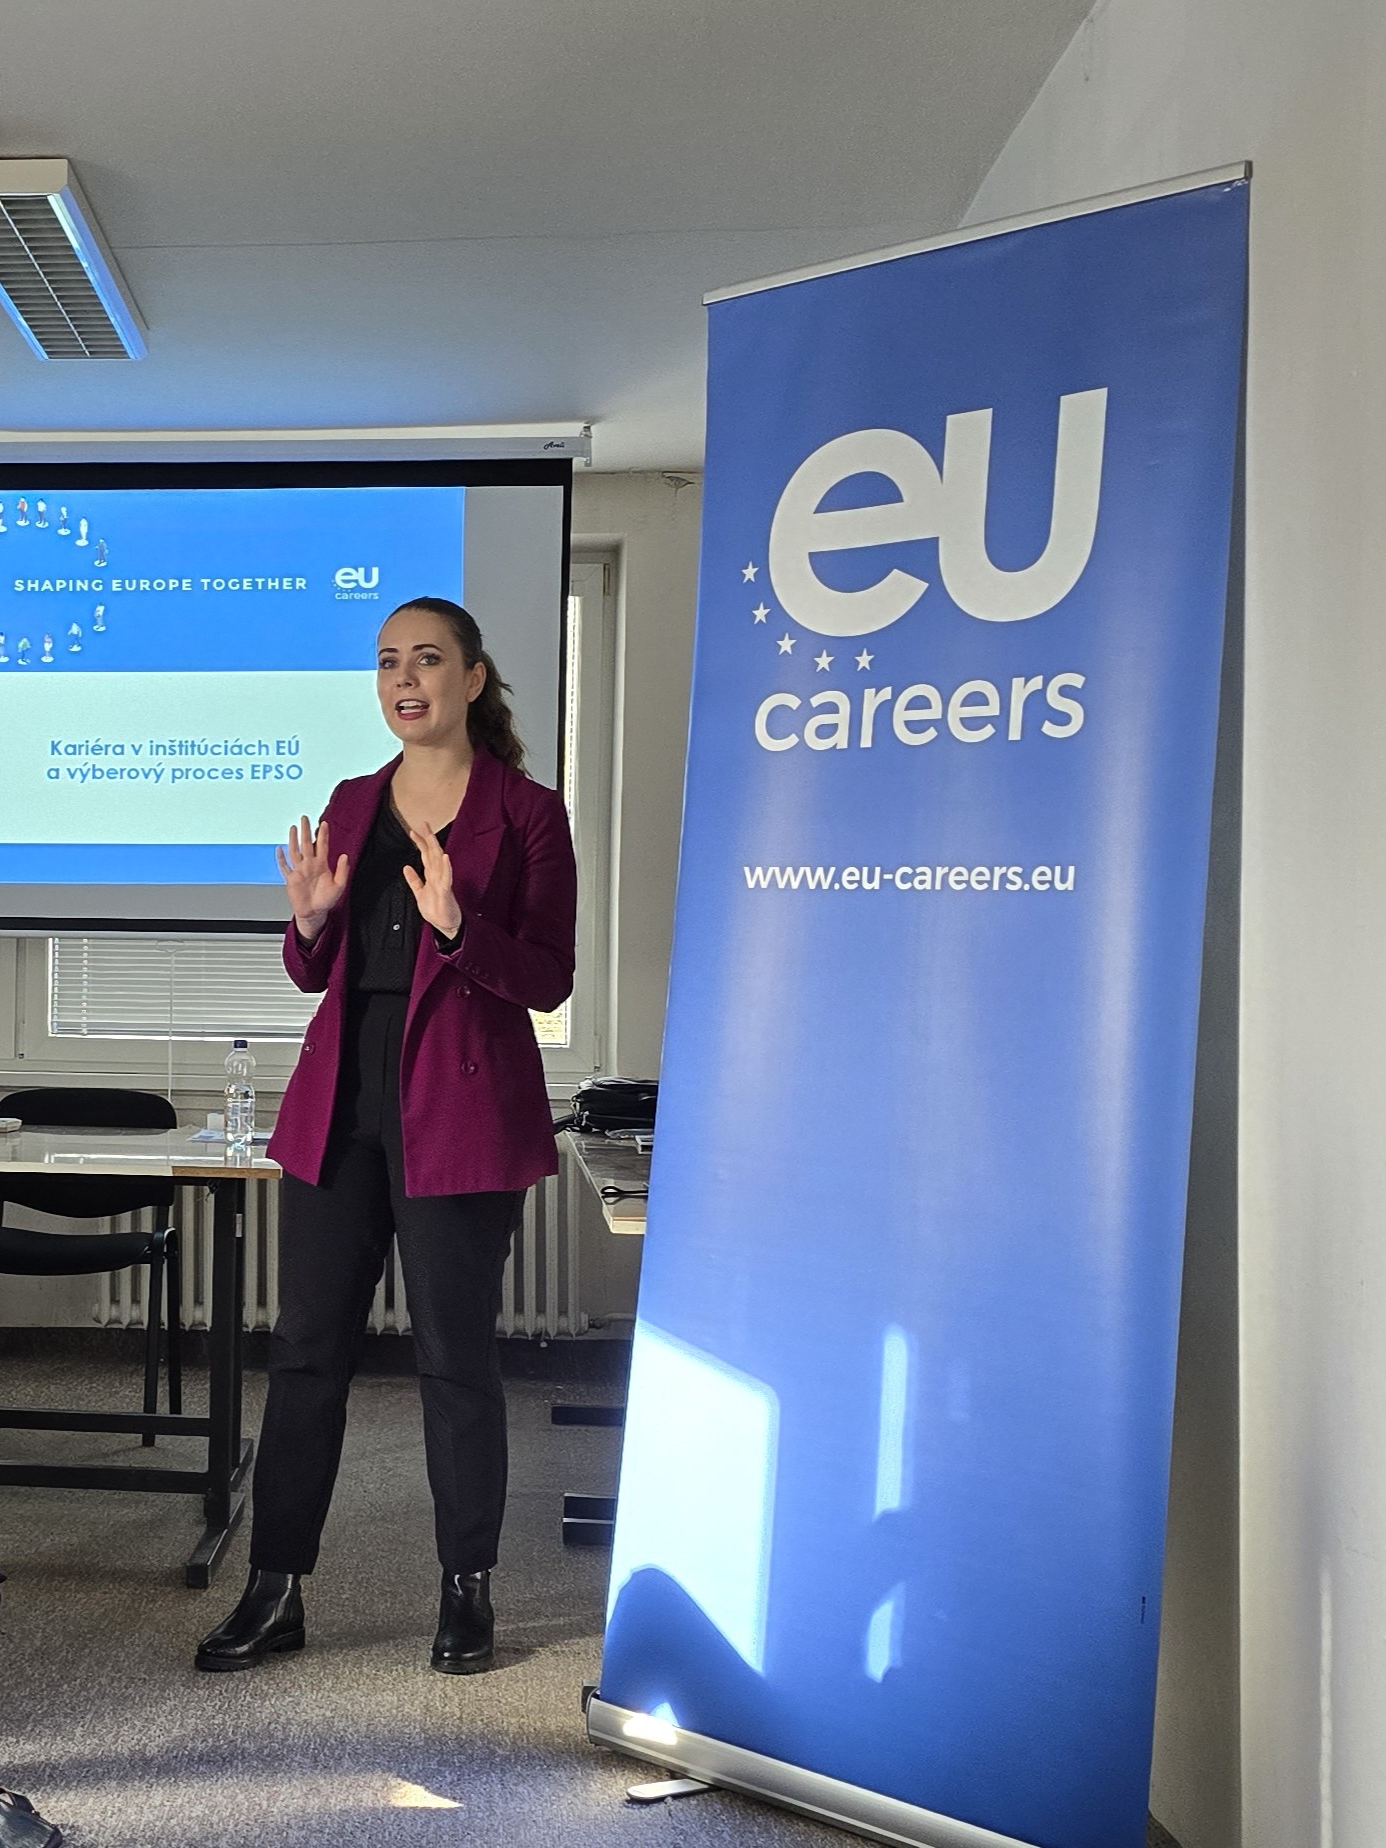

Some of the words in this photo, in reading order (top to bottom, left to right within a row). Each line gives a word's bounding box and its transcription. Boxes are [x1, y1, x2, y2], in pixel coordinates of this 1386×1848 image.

[14, 579, 103, 592] SHAPING
[112, 579, 192, 591] EUROPE
[200, 577, 307, 591] TOGETHER
[334, 592, 379, 600] careers
[754, 672, 1086, 753] careers
[50, 738, 125, 756] Kariéra
[130, 743, 143, 756] v
[149, 738, 269, 756] inštitúciách
[276, 735, 300, 756] EÚ
[46, 767, 60, 780] a
[66, 762, 165, 784] výberový
[171, 767, 244, 784] proces
[250, 763, 303, 780] EPSO
[743, 864, 1076, 892] www.eu-careers.eu
